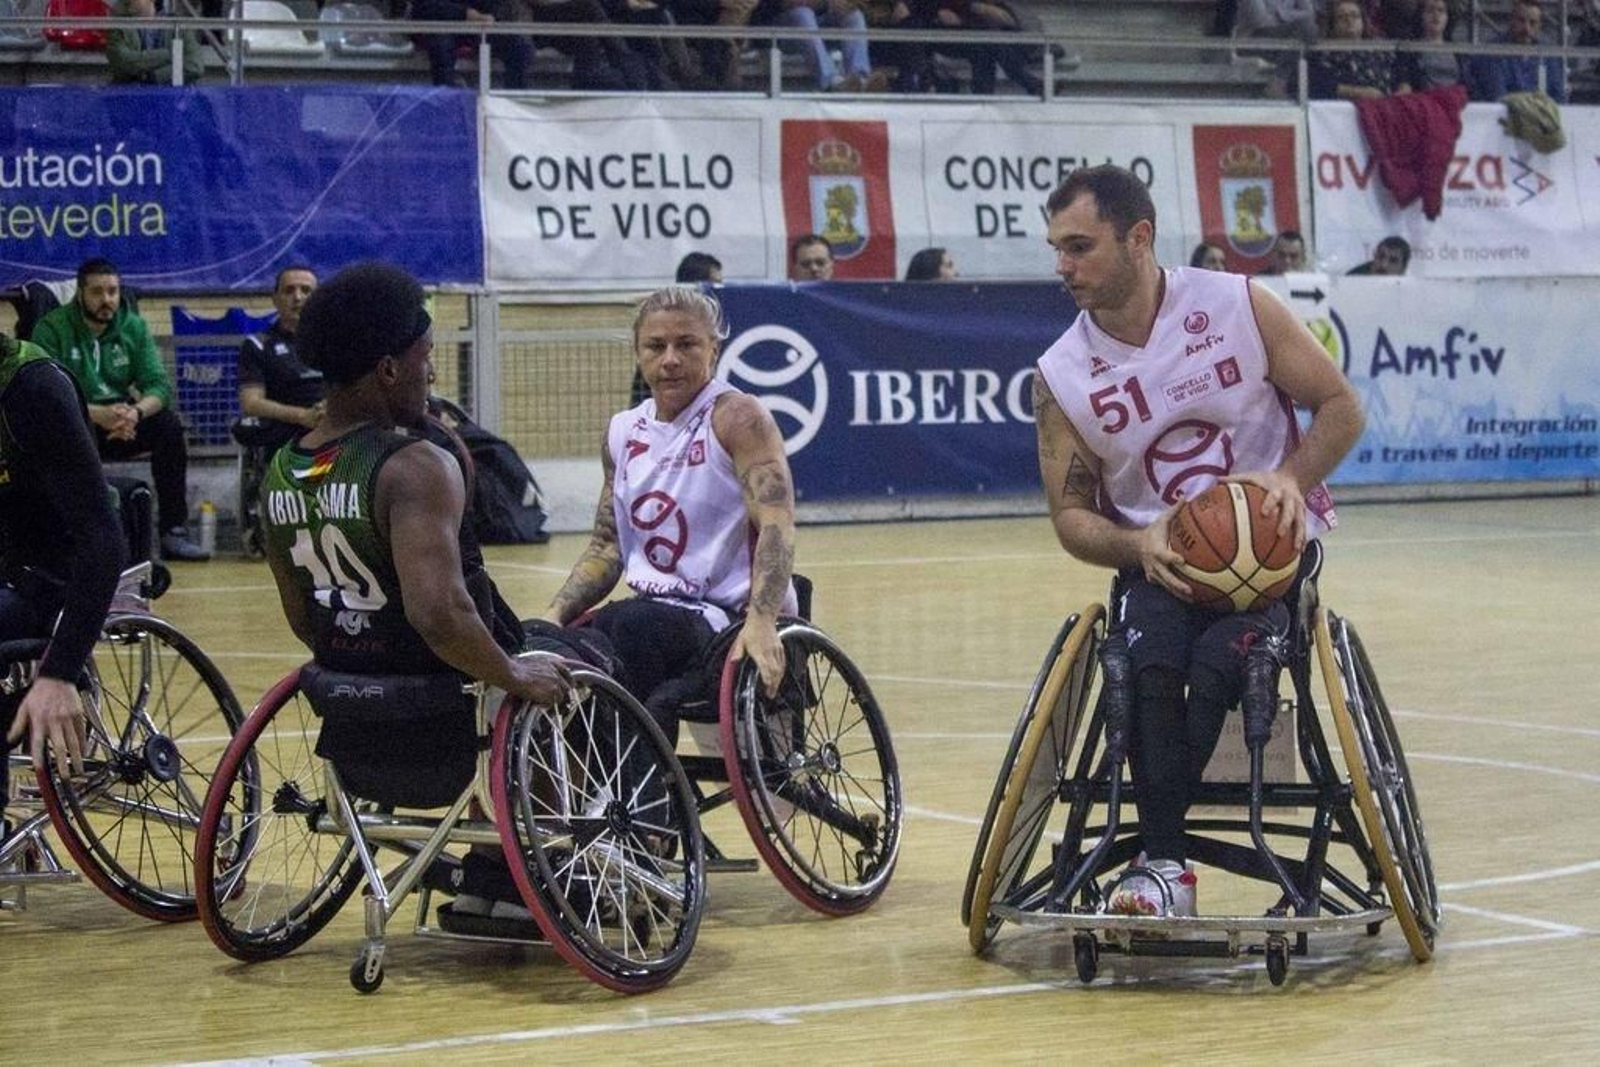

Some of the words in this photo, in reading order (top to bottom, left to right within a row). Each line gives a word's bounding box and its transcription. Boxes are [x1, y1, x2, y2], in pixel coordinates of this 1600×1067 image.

[0, 142, 163, 188] utación
[508, 153, 733, 191] CONCELLO
[944, 156, 1154, 191] CONCEO
[1317, 152, 1505, 190] avza
[537, 205, 596, 240] DE
[612, 203, 712, 240] VIGO
[975, 204, 1027, 238] DE
[1186, 334, 1224, 357] Amfiv
[1370, 326, 1505, 379] Amfiv
[1167, 373, 1211, 396] CONCELLO
[1174, 392, 1186, 402] DE
[1188, 383, 1209, 396] VIGO
[1088, 375, 1152, 435] 51
[1466, 414, 1597, 438] Integración
[1358, 449, 1373, 463] a
[1382, 443, 1457, 463] través
[1466, 443, 1500, 460] del
[1508, 442, 1599, 463] deporte
[290, 523, 388, 609] 10
[327, 684, 384, 699] JAMA
